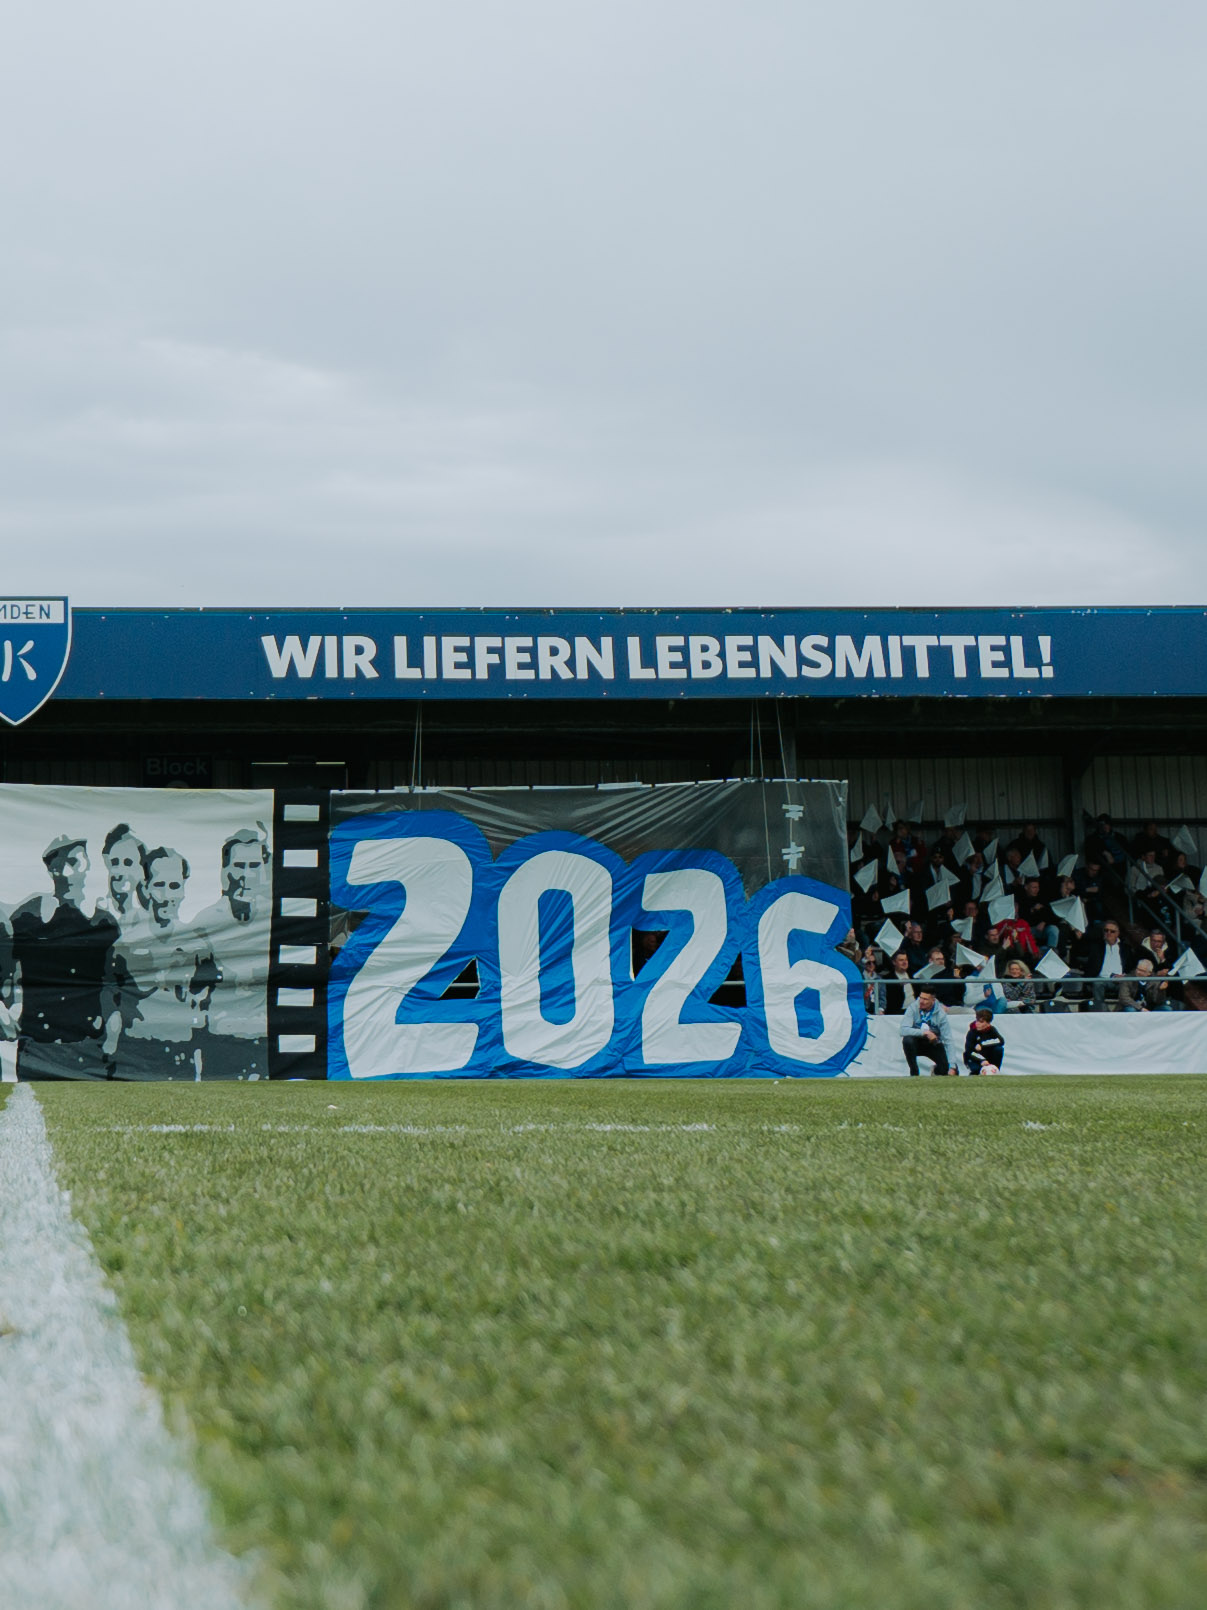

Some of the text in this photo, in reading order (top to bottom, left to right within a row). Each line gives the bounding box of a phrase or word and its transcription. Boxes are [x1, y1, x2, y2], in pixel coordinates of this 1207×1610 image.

[1, 639, 37, 682] K
[260, 634, 1054, 680] WIR LIEFERN LEBENSMITTEL!
[146, 757, 208, 776] Block
[342, 835, 853, 1079] 2026
